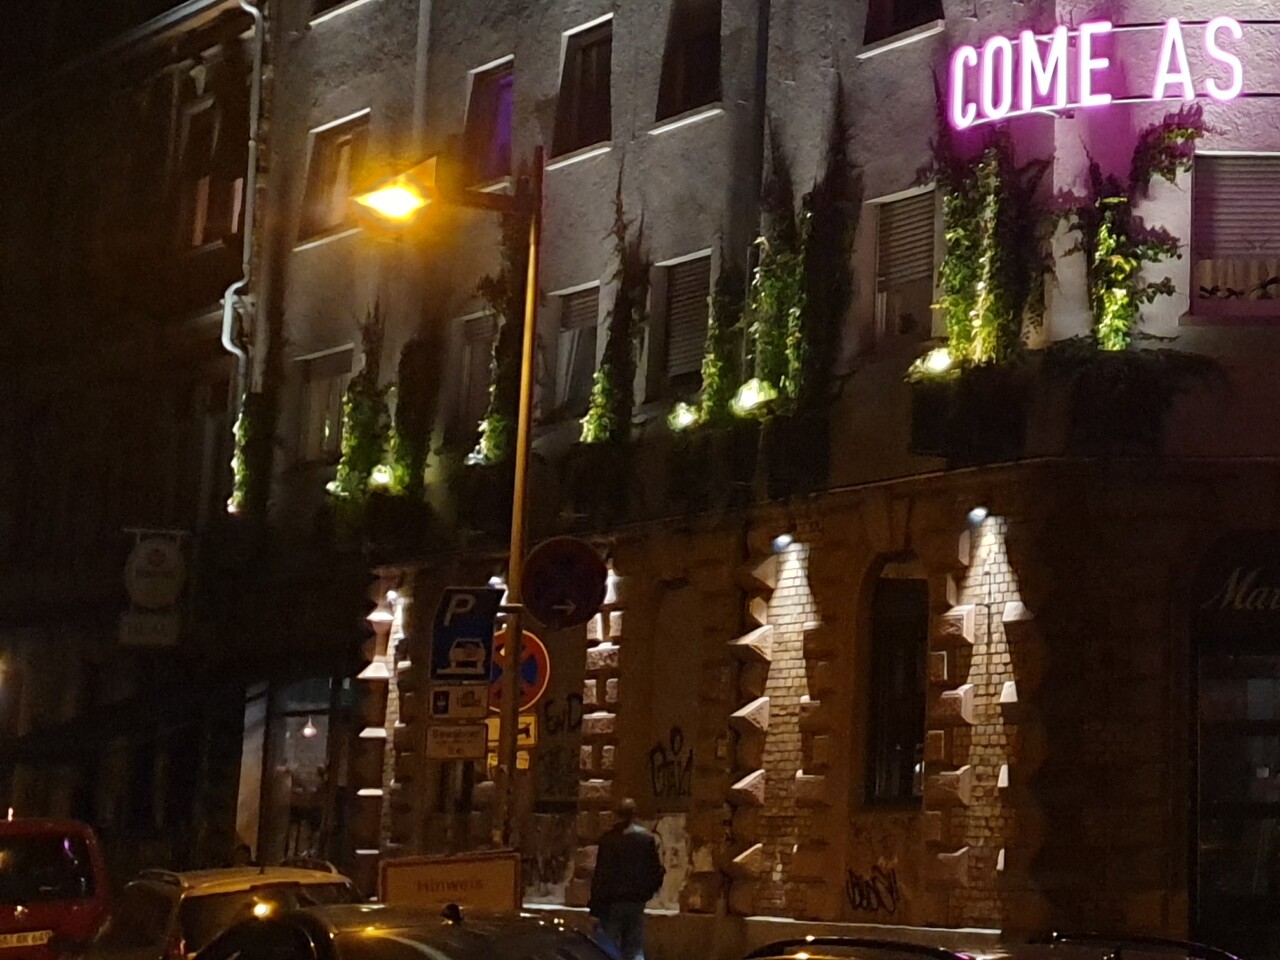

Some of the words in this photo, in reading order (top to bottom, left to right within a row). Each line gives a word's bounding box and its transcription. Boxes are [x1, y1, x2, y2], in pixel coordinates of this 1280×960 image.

[951, 21, 1113, 129] COME
[1154, 17, 1244, 101] AS
[443, 593, 477, 627] P
